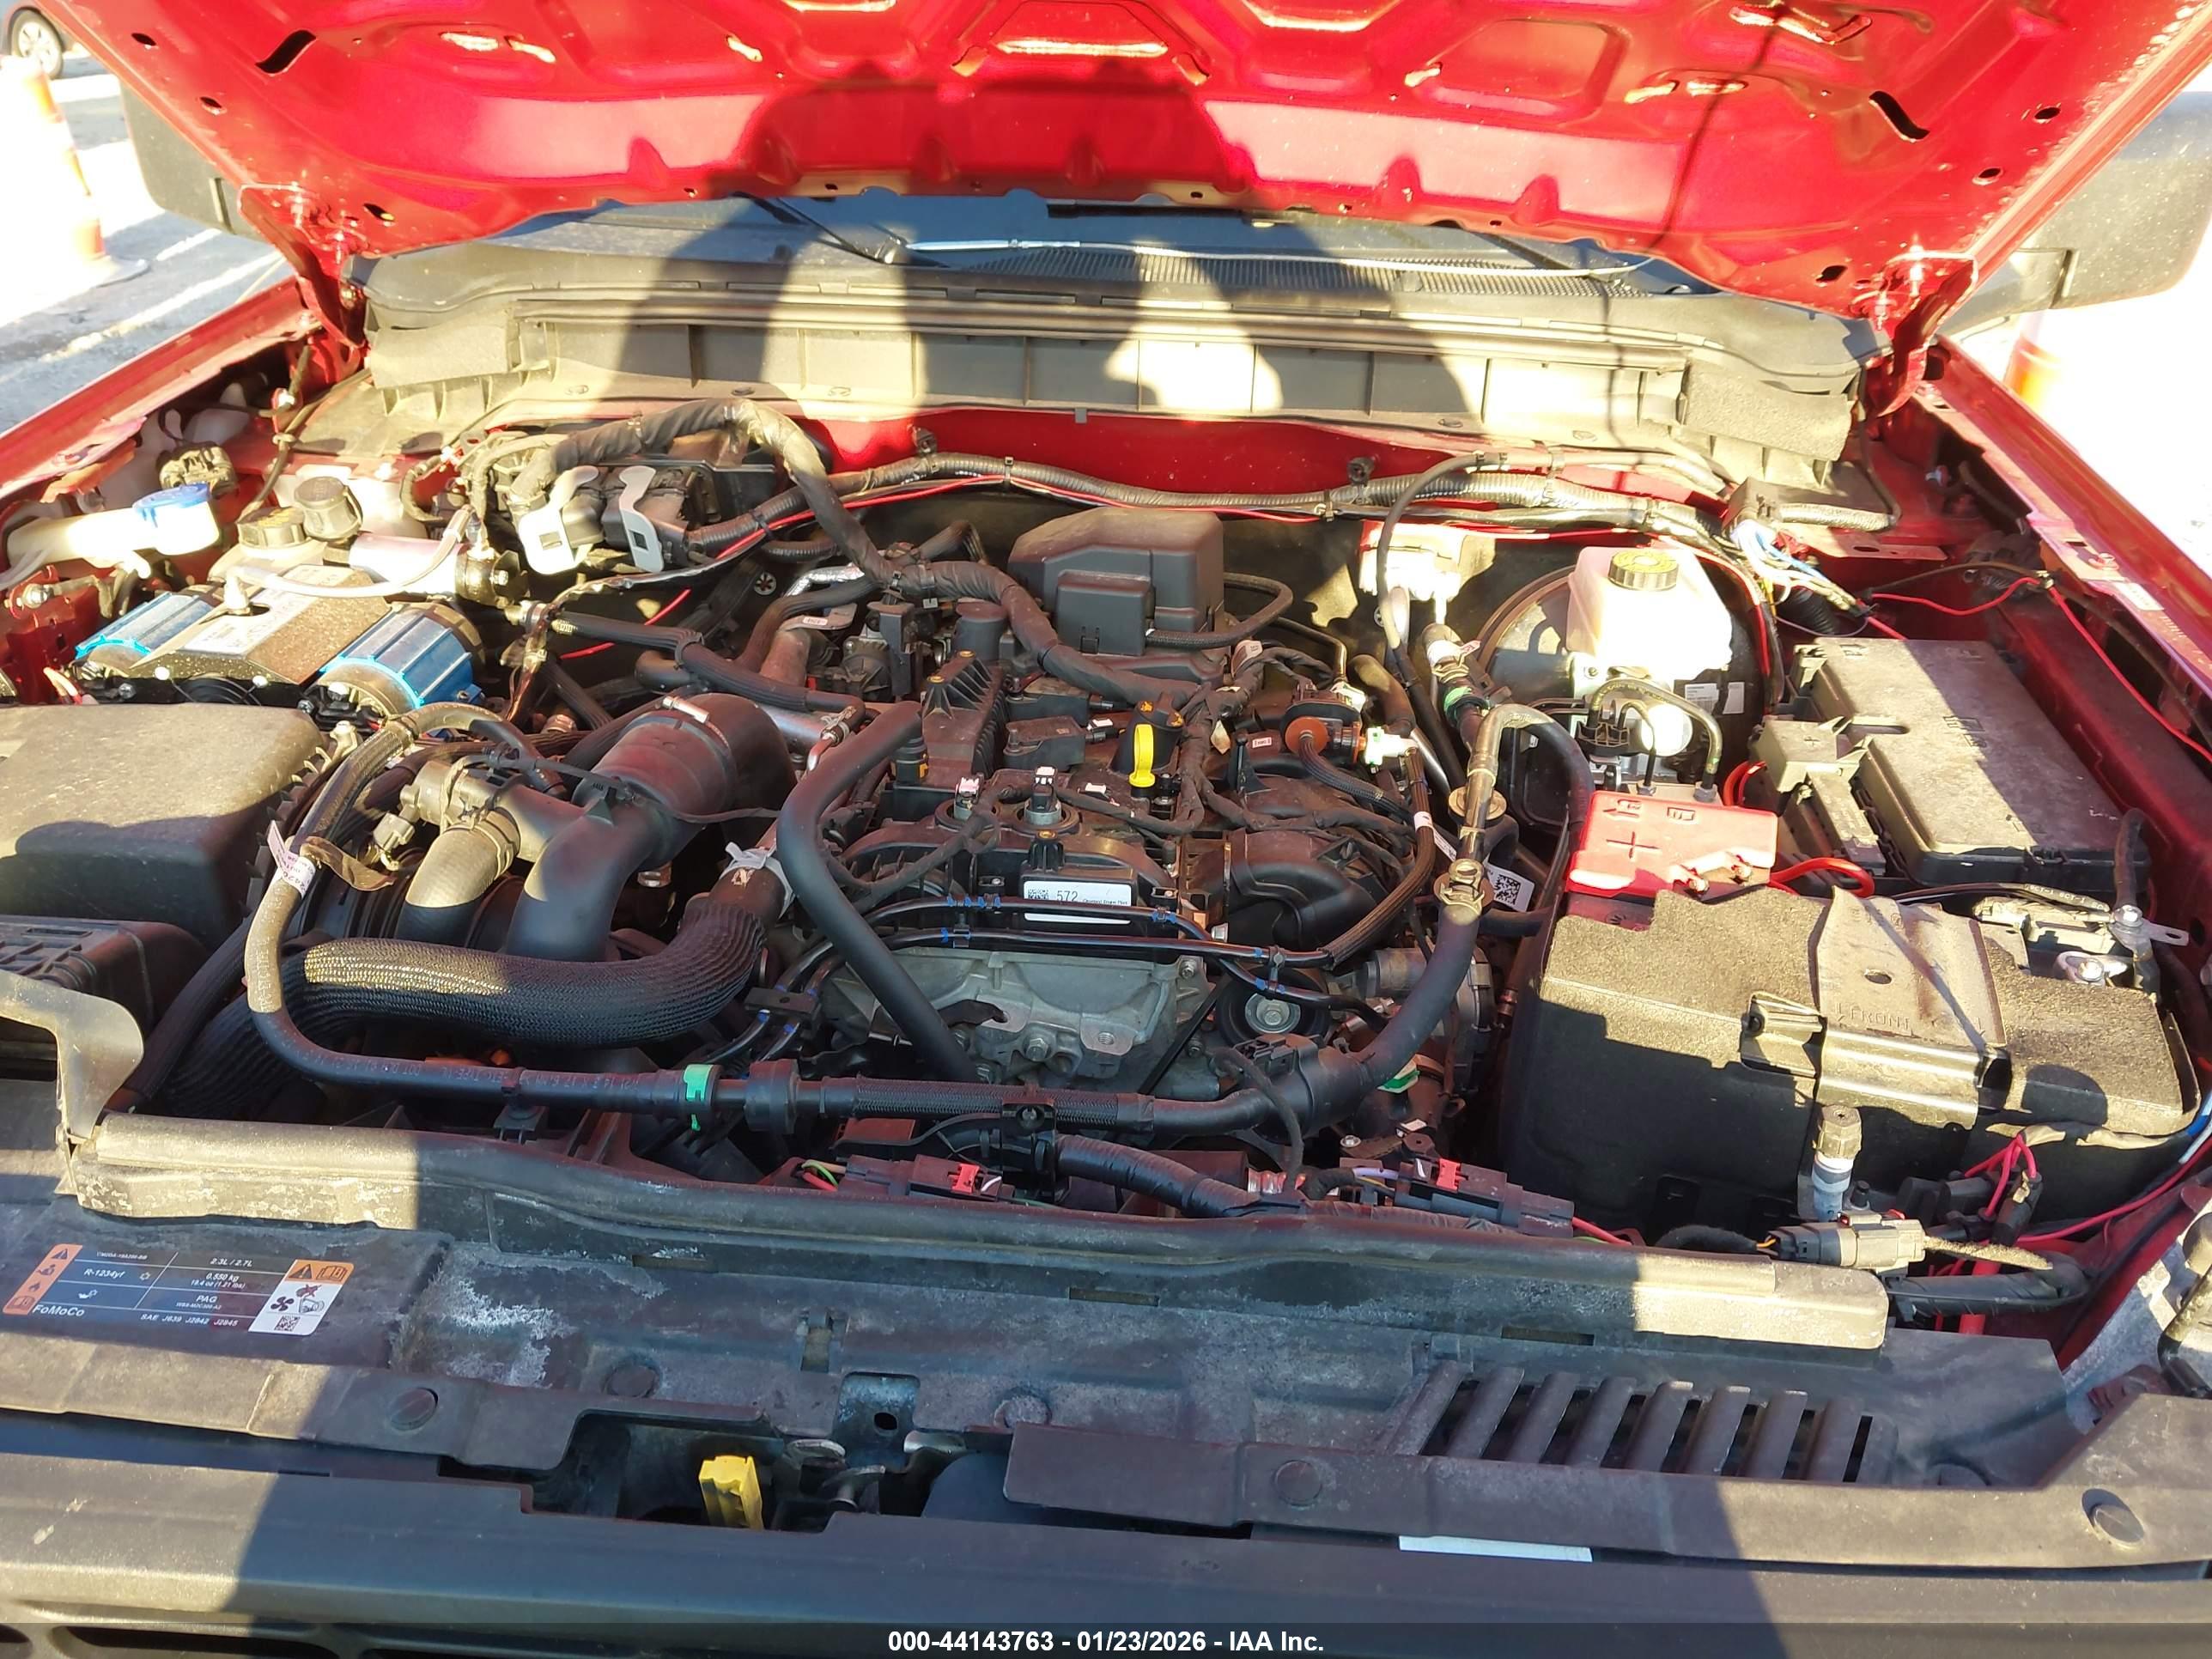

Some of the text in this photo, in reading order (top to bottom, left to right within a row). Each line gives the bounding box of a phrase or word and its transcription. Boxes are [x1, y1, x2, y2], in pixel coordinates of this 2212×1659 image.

[1056, 890, 1079, 902] 572
[83, 1267, 126, 1279] R-1234yf
[228, 1273, 240, 1283] kg
[196, 1295, 218, 1304] PAG
[32, 1304, 85, 1317] FoMoCo
[140, 1313, 160, 1322] SAE
